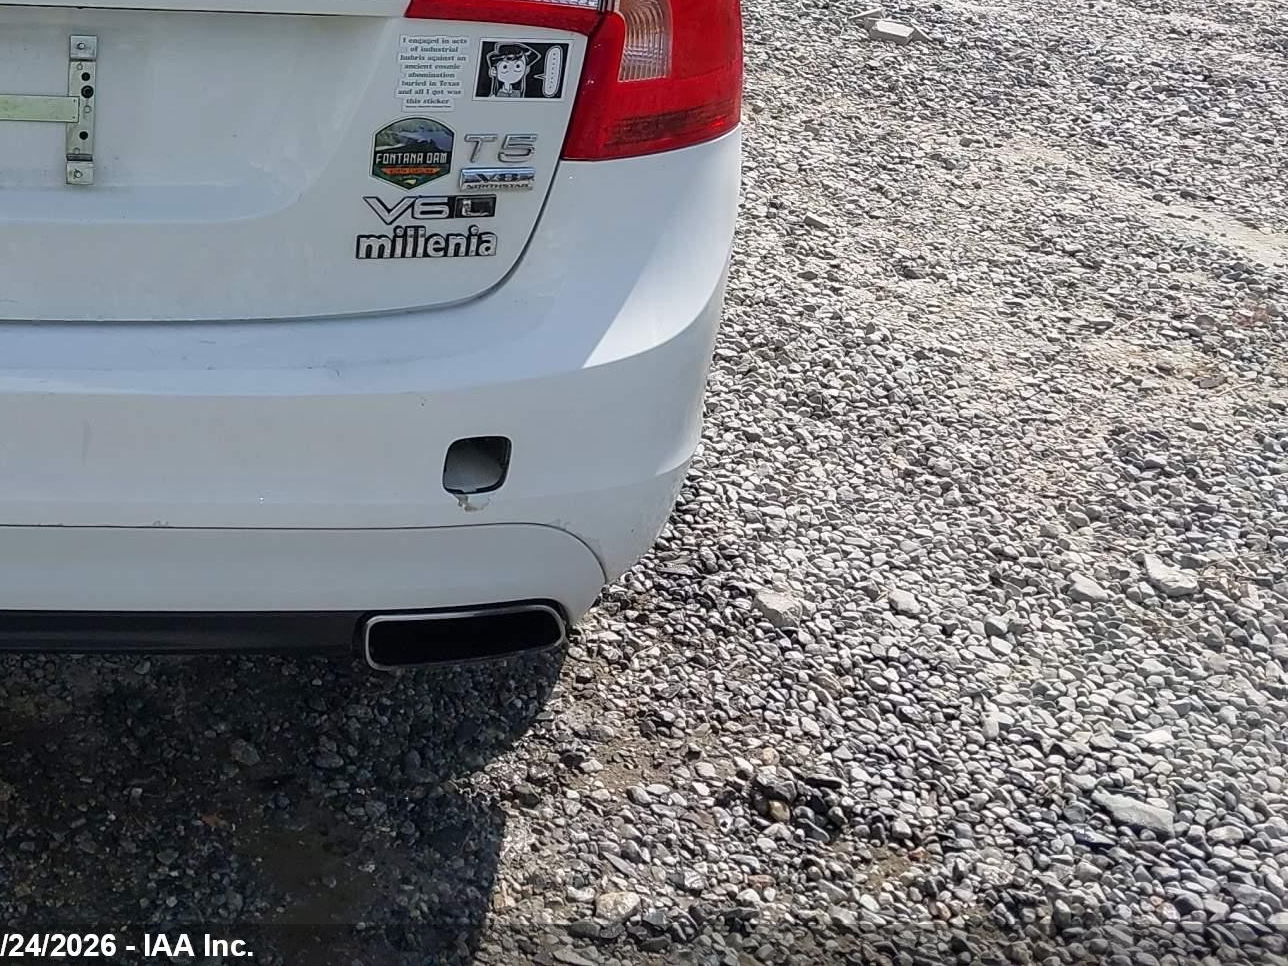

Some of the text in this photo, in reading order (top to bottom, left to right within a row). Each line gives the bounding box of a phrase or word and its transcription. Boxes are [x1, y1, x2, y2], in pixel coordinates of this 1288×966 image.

[376, 153, 446, 164] FONTANA DAM
[464, 134, 538, 163] T5
[356, 225, 497, 258] millenia
